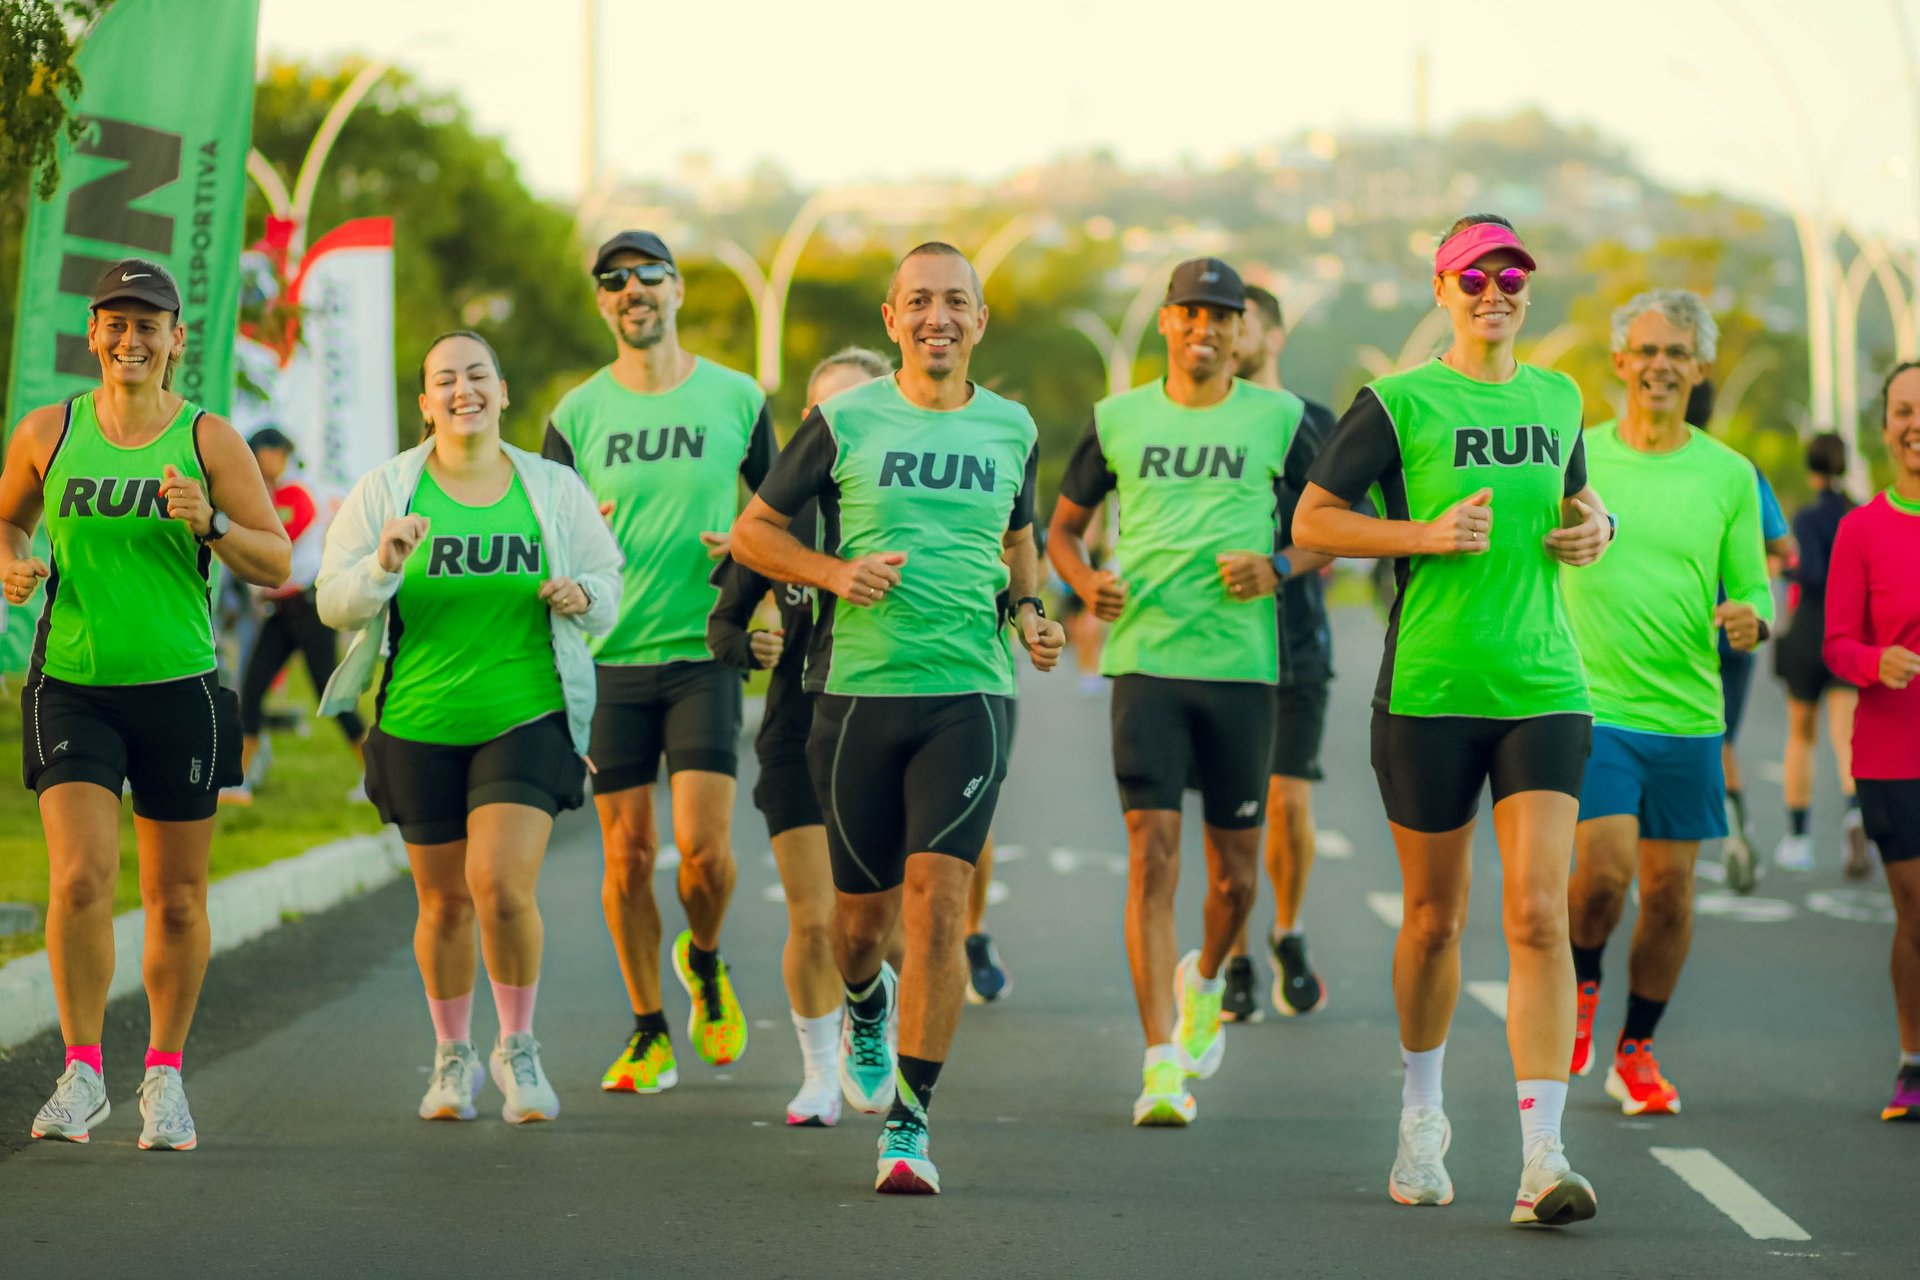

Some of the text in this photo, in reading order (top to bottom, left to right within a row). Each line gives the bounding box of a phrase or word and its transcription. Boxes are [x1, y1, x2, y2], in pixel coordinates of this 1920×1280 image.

[187, 138, 218, 305] ESPORTIVA
[604, 427, 706, 467] RUN
[1139, 446, 1246, 479] RUN
[1452, 426, 1560, 468] RUN
[878, 451, 996, 493] RUN
[427, 534, 541, 576] RUN
